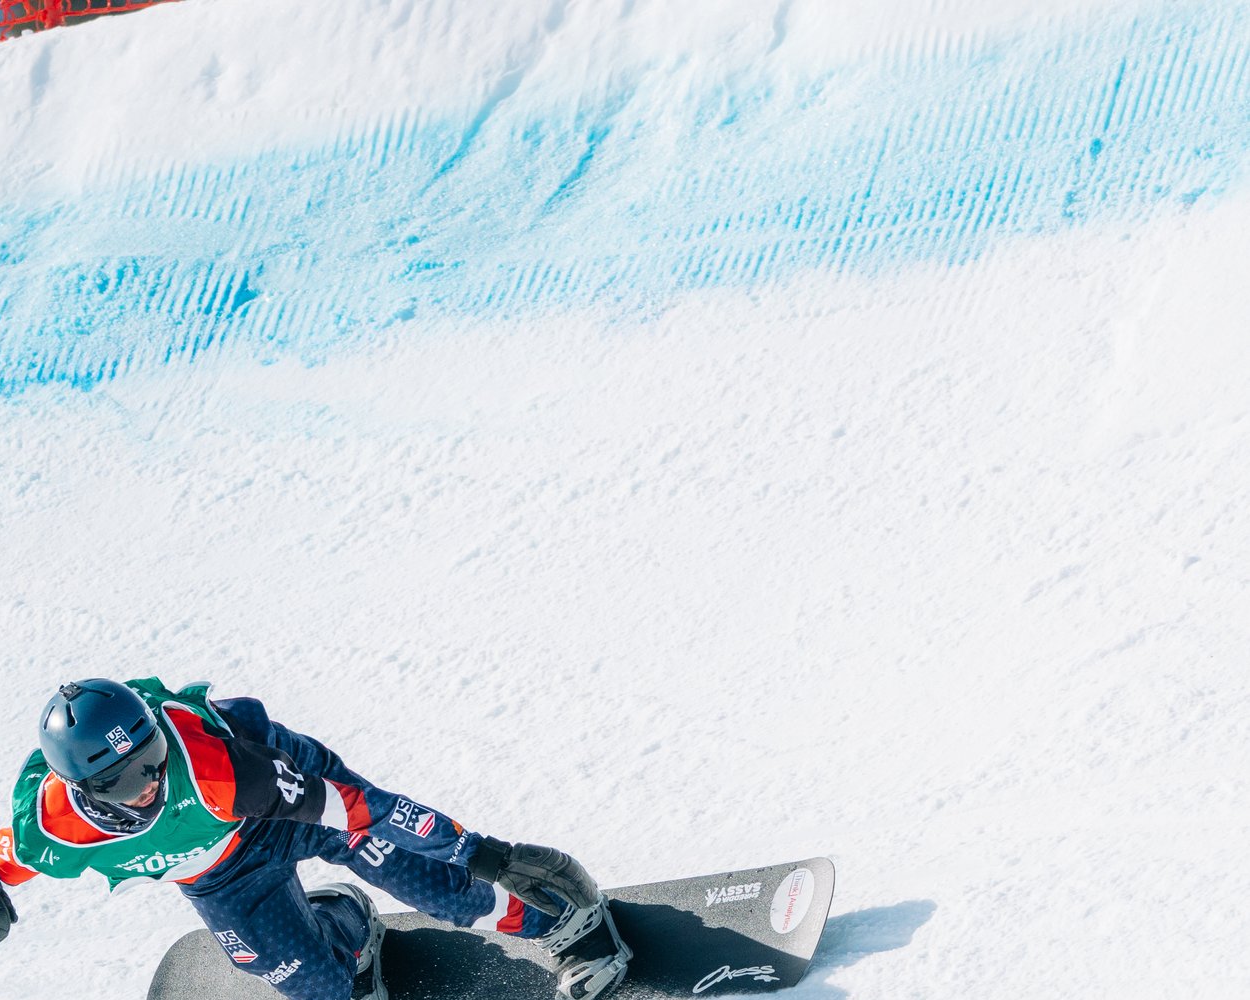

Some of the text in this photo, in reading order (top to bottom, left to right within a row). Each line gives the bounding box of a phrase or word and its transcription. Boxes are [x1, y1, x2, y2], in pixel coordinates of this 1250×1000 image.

[107, 727, 123, 741] US
[272, 759, 305, 804] 47
[391, 800, 412, 826] US
[216, 931, 239, 945] US
